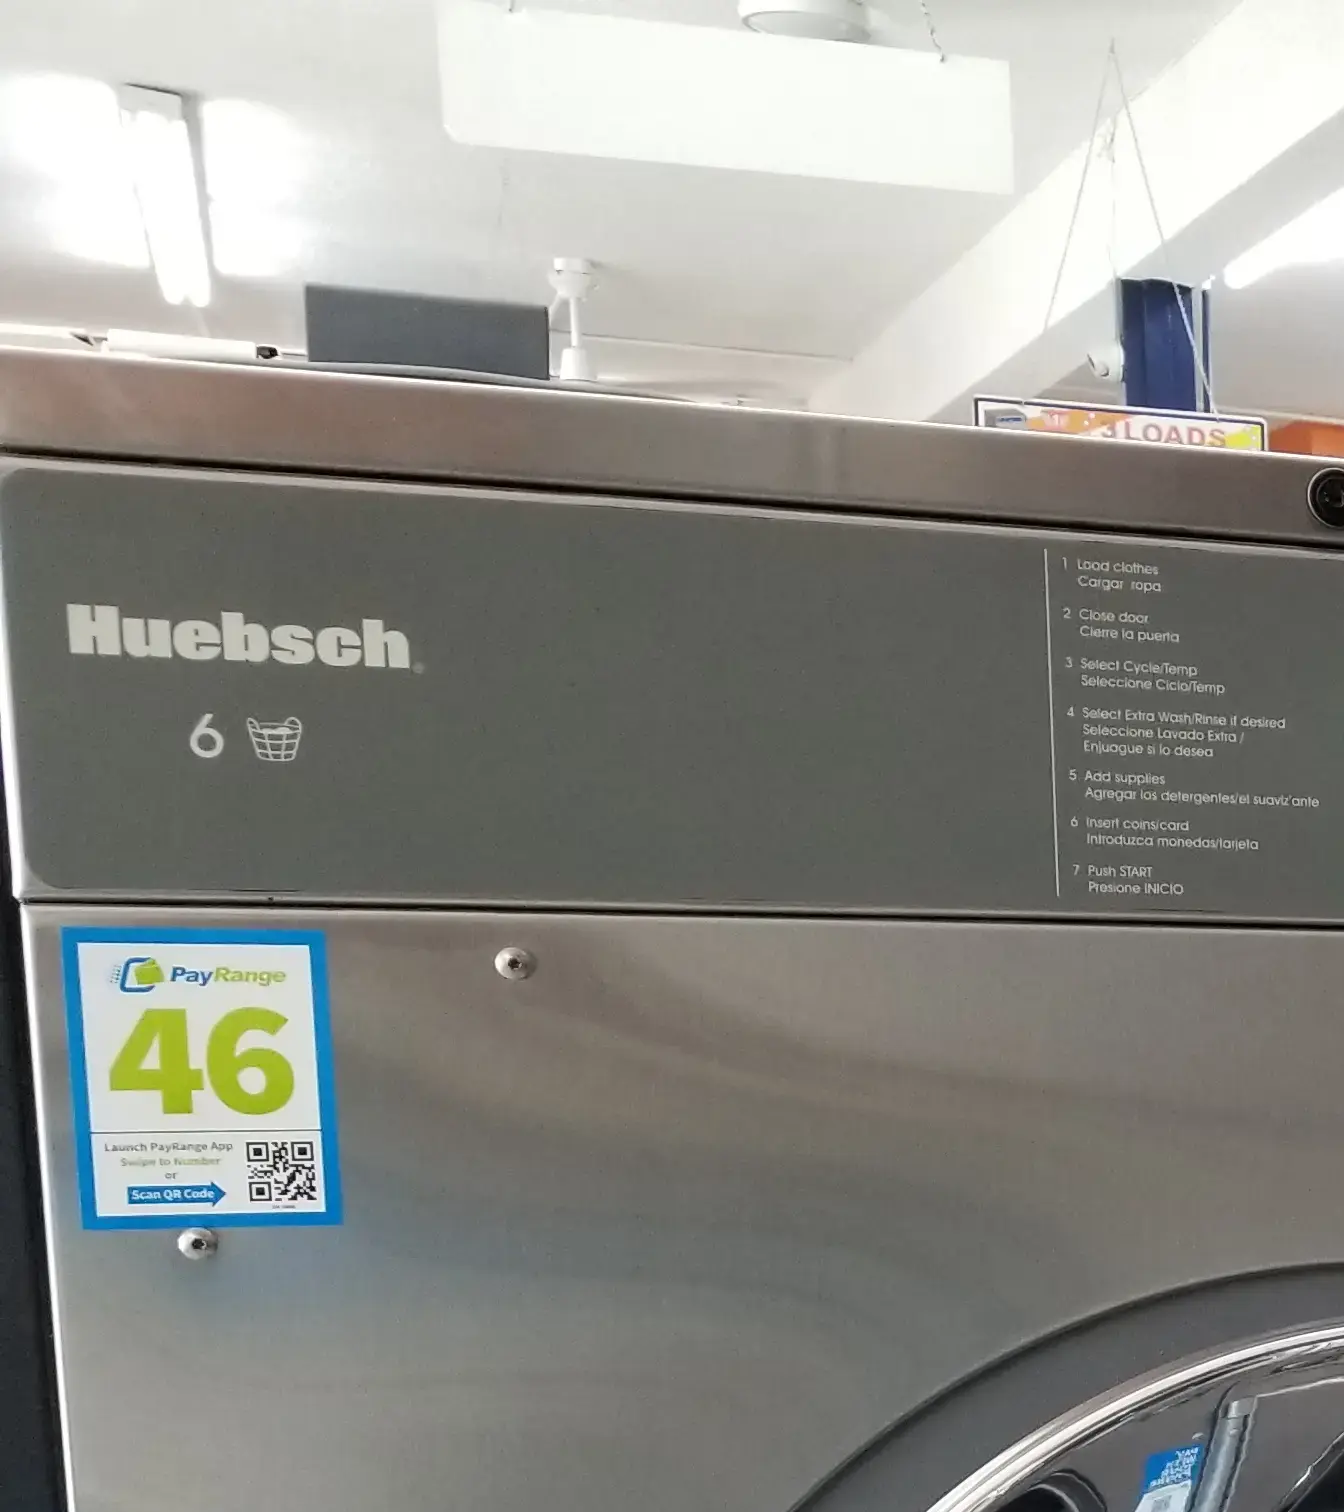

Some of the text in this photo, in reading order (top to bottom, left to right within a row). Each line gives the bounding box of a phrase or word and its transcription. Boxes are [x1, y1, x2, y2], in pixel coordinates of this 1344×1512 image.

[1125, 422, 1226, 447] LOADS
[1077, 559, 1159, 575] Load clothes
[1078, 576, 1162, 593] Cargar ropa
[1063, 608, 1149, 623] 2 Close door
[67, 603, 411, 668] Huebsch
[1080, 626, 1180, 643] Cierre la puerta
[1065, 657, 1198, 677] 3 Select Cycle/Temp
[1081, 675, 1225, 695] Seleccione Ciclo/Temp
[1067, 707, 1286, 729] 4 Select Extra Wash/Rinse if desired
[189, 713, 223, 758] 6
[1082, 724, 1237, 743] Seleccione Lavado Extra
[1084, 740, 1214, 757] Enjuague si lo desea
[1069, 770, 1165, 786] 5 Add supplies
[1085, 787, 1136, 801] Agregar
[1140, 788, 1157, 800] los
[1070, 816, 1189, 831] 6 Insert coins/card
[1087, 834, 1259, 851] Introduzca monedas/tarjeta
[1073, 864, 1153, 878] 7 Push START
[1088, 882, 1184, 895] Presione INICIO
[171, 966, 286, 986] PayRange
[109, 1006, 295, 1116] 46
[104, 1141, 233, 1153] Launch PayRange App
[121, 1156, 220, 1168] Swipe to Number
[164, 1172, 178, 1180] or
[131, 1188, 215, 1201] Scan QR Code
